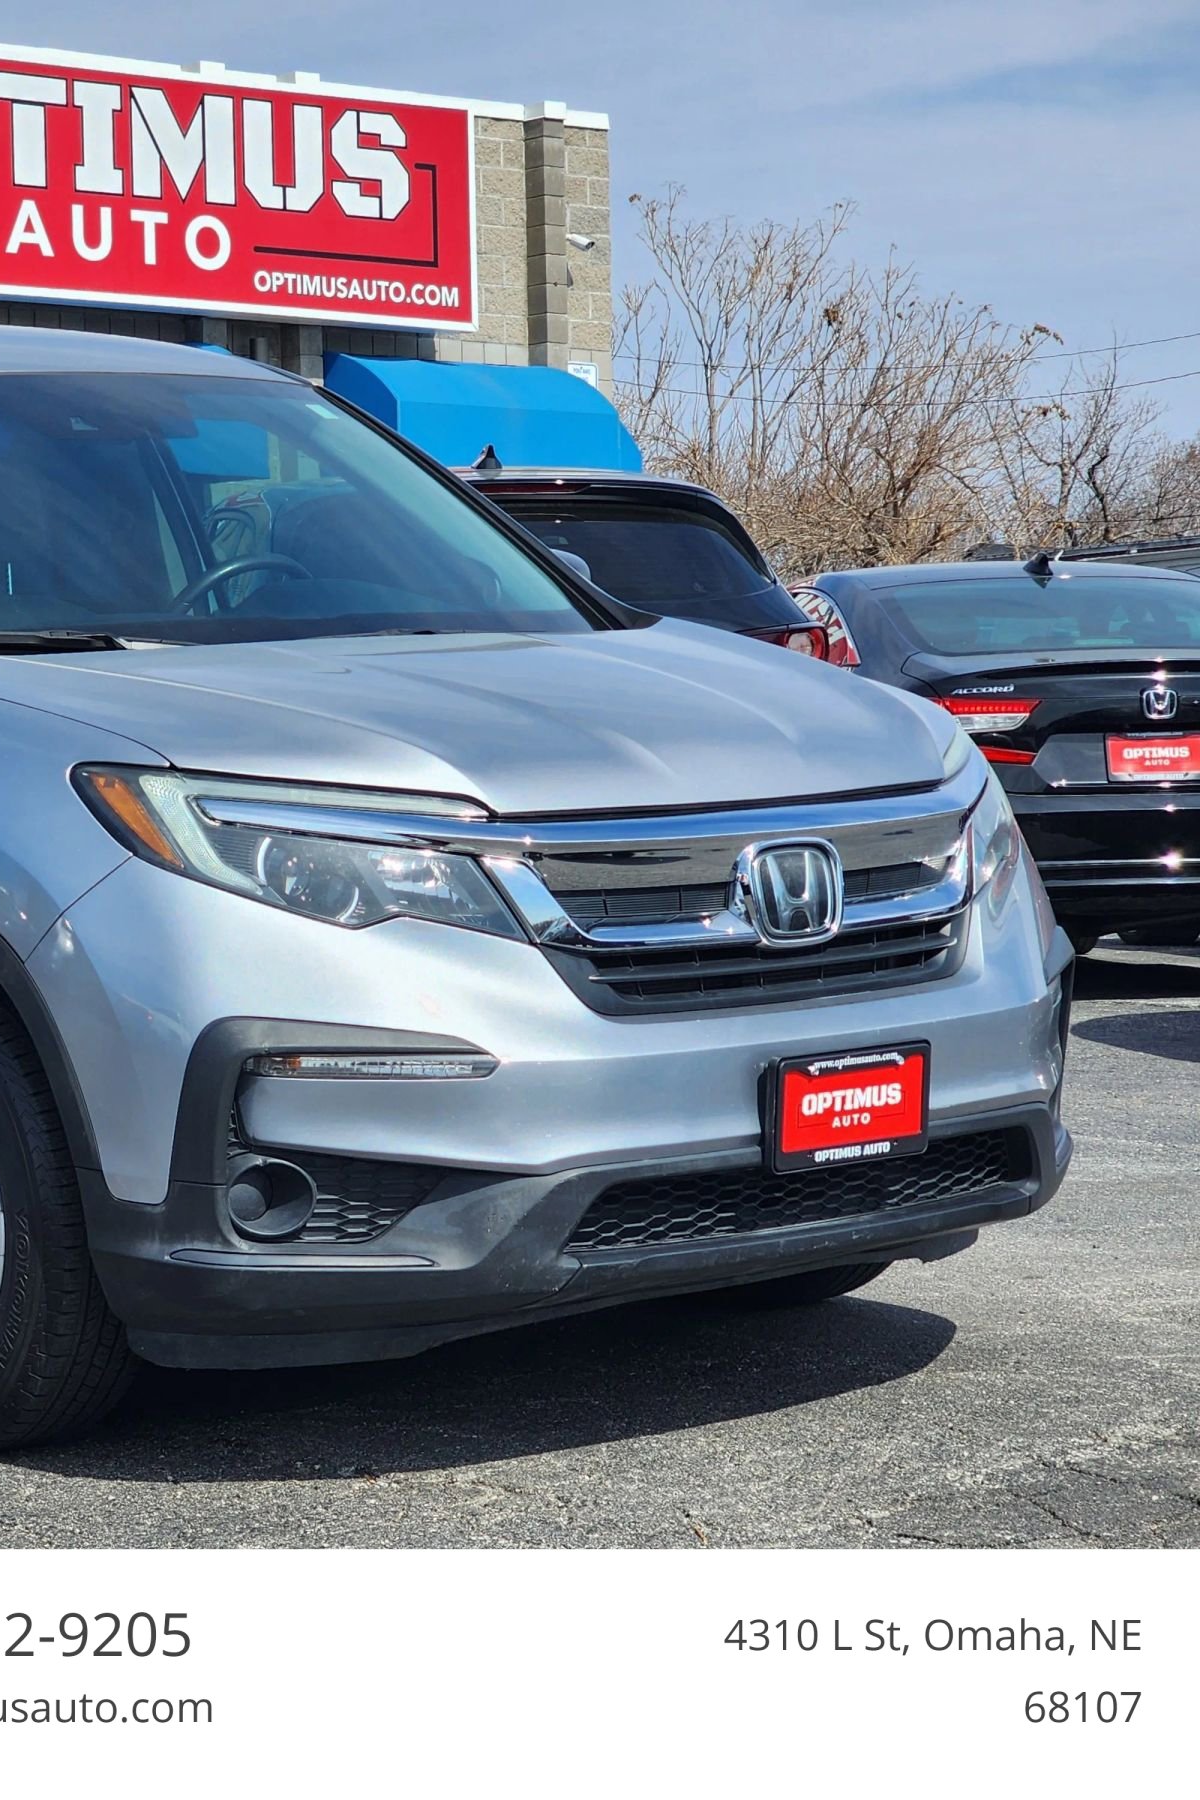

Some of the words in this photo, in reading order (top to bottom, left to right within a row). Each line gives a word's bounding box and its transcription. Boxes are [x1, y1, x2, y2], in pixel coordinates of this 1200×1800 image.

[6, 200, 232, 271] AUTO
[253, 271, 460, 308] OPTIMUSAUTO.COM
[951, 684, 1014, 695] ACCORD
[1123, 747, 1190, 759] OPTIMUS
[801, 1083, 902, 1116] OPTIMUS
[832, 1113, 871, 1128] AUTO
[814, 1145, 862, 1162] OPTIMUS
[863, 1142, 891, 1156] AUTO
